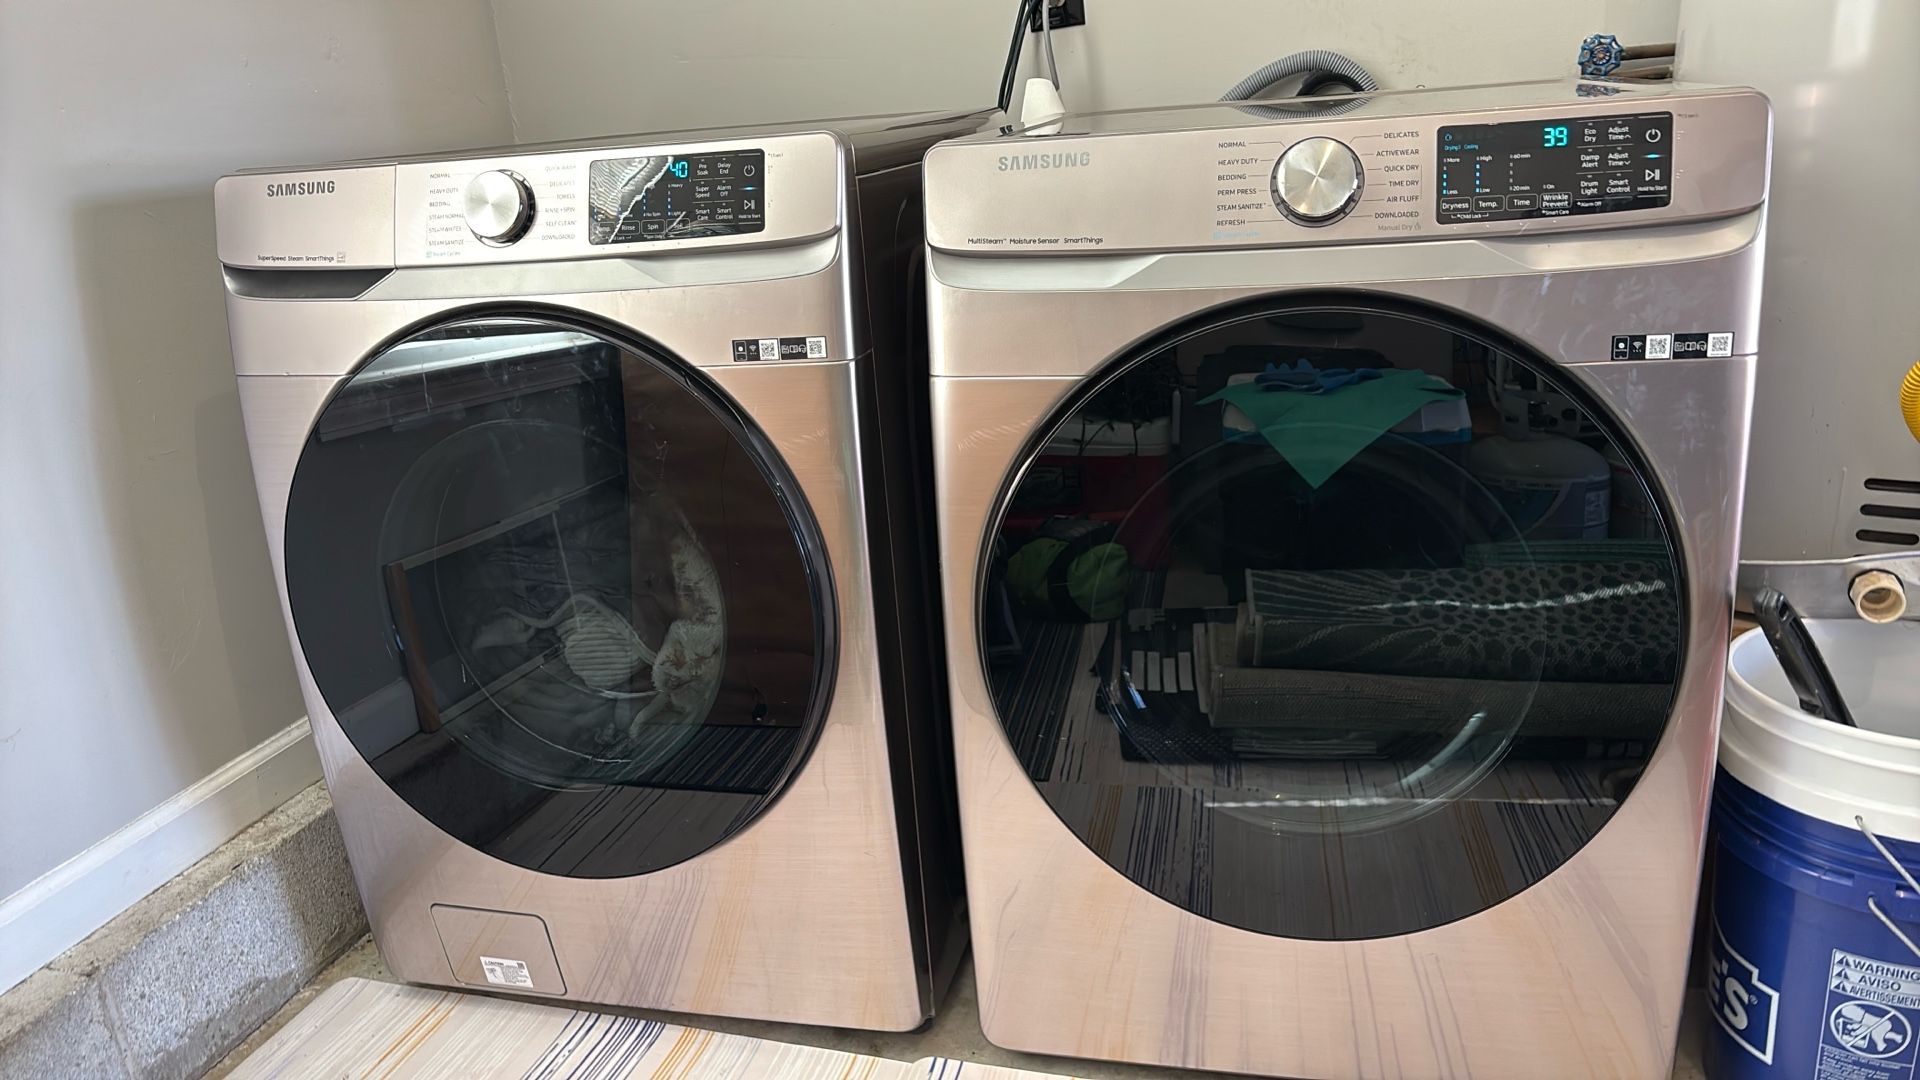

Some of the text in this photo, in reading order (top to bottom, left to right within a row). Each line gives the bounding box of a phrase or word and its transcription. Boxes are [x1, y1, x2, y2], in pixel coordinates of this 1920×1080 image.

[1608, 126, 1629, 134] Adjust
[1383, 131, 1420, 139] DELICATES
[1544, 127, 1568, 147] 39
[1584, 135, 1597, 143] Dry
[1218, 141, 1246, 149] NORMAL
[1376, 148, 1420, 157] ACTIVEWEAR
[998, 151, 1091, 172] SAMSUNG
[1218, 157, 1258, 166] HEAVY DUTY
[1580, 154, 1600, 162] Damp
[669, 161, 688, 178] 40
[1384, 164, 1420, 173] QUICK DRY
[1217, 173, 1247, 181] BEDDING
[1405, 179, 1420, 187] DRY
[267, 180, 336, 198] SAMSUNG
[1217, 187, 1257, 196] PERM PRESS
[1580, 187, 1598, 195] Light
[1543, 193, 1569, 201] Wrinkle
[1216, 204, 1237, 212] STEAM
[1374, 210, 1420, 219] DOWNLOADED
[1216, 219, 1246, 227] REFRESH
[1377, 223, 1413, 232] Manual Dry
[1063, 236, 1104, 245] SmartThings
[257, 255, 287, 263] SuperSpeed
[305, 255, 335, 263] SmartThings
[1853, 959, 1920, 981] WARNING
[1858, 975, 1902, 992] AVISO
